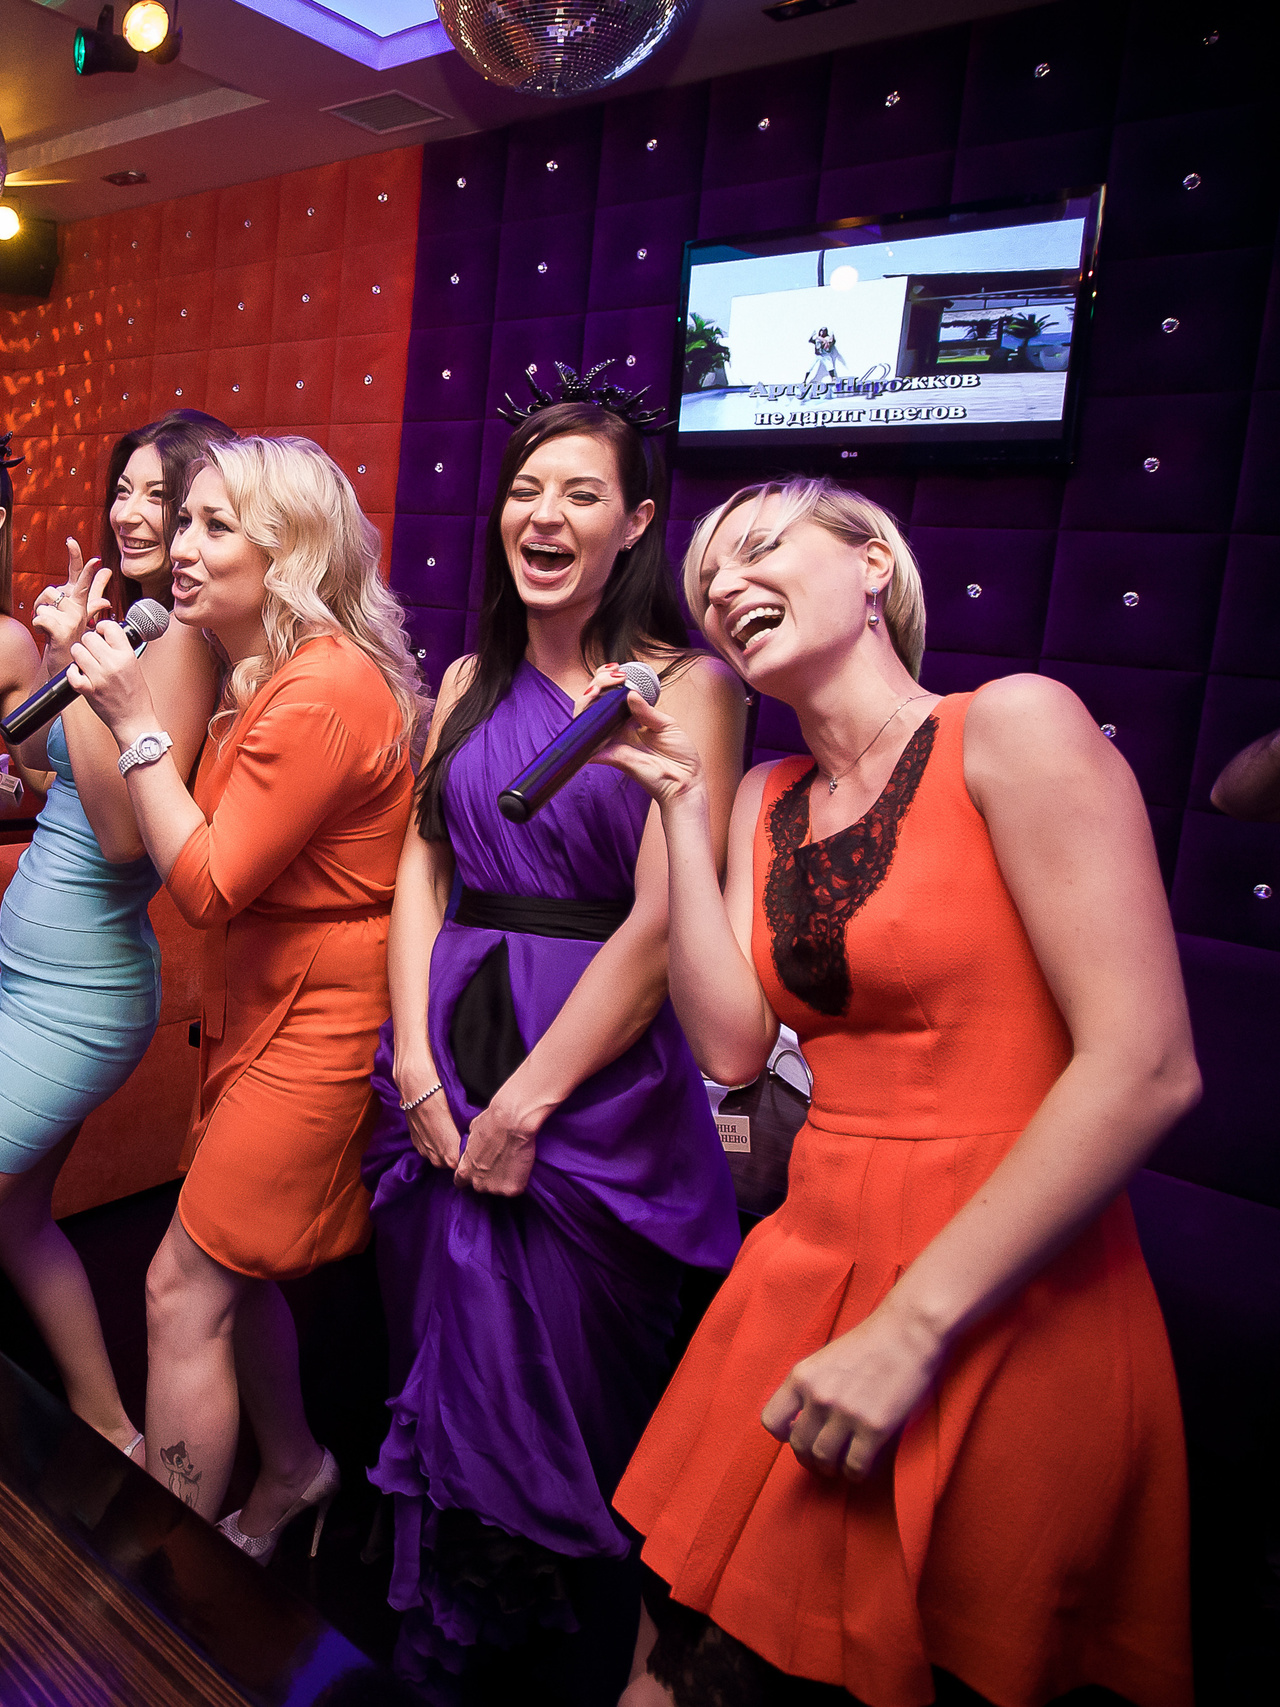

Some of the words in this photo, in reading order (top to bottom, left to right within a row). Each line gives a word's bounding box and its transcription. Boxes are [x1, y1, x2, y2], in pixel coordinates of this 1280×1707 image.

[749, 380, 828, 401] Артур
[754, 411, 785, 426] не
[787, 408, 866, 428] дарит
[869, 405, 968, 424] цветов
